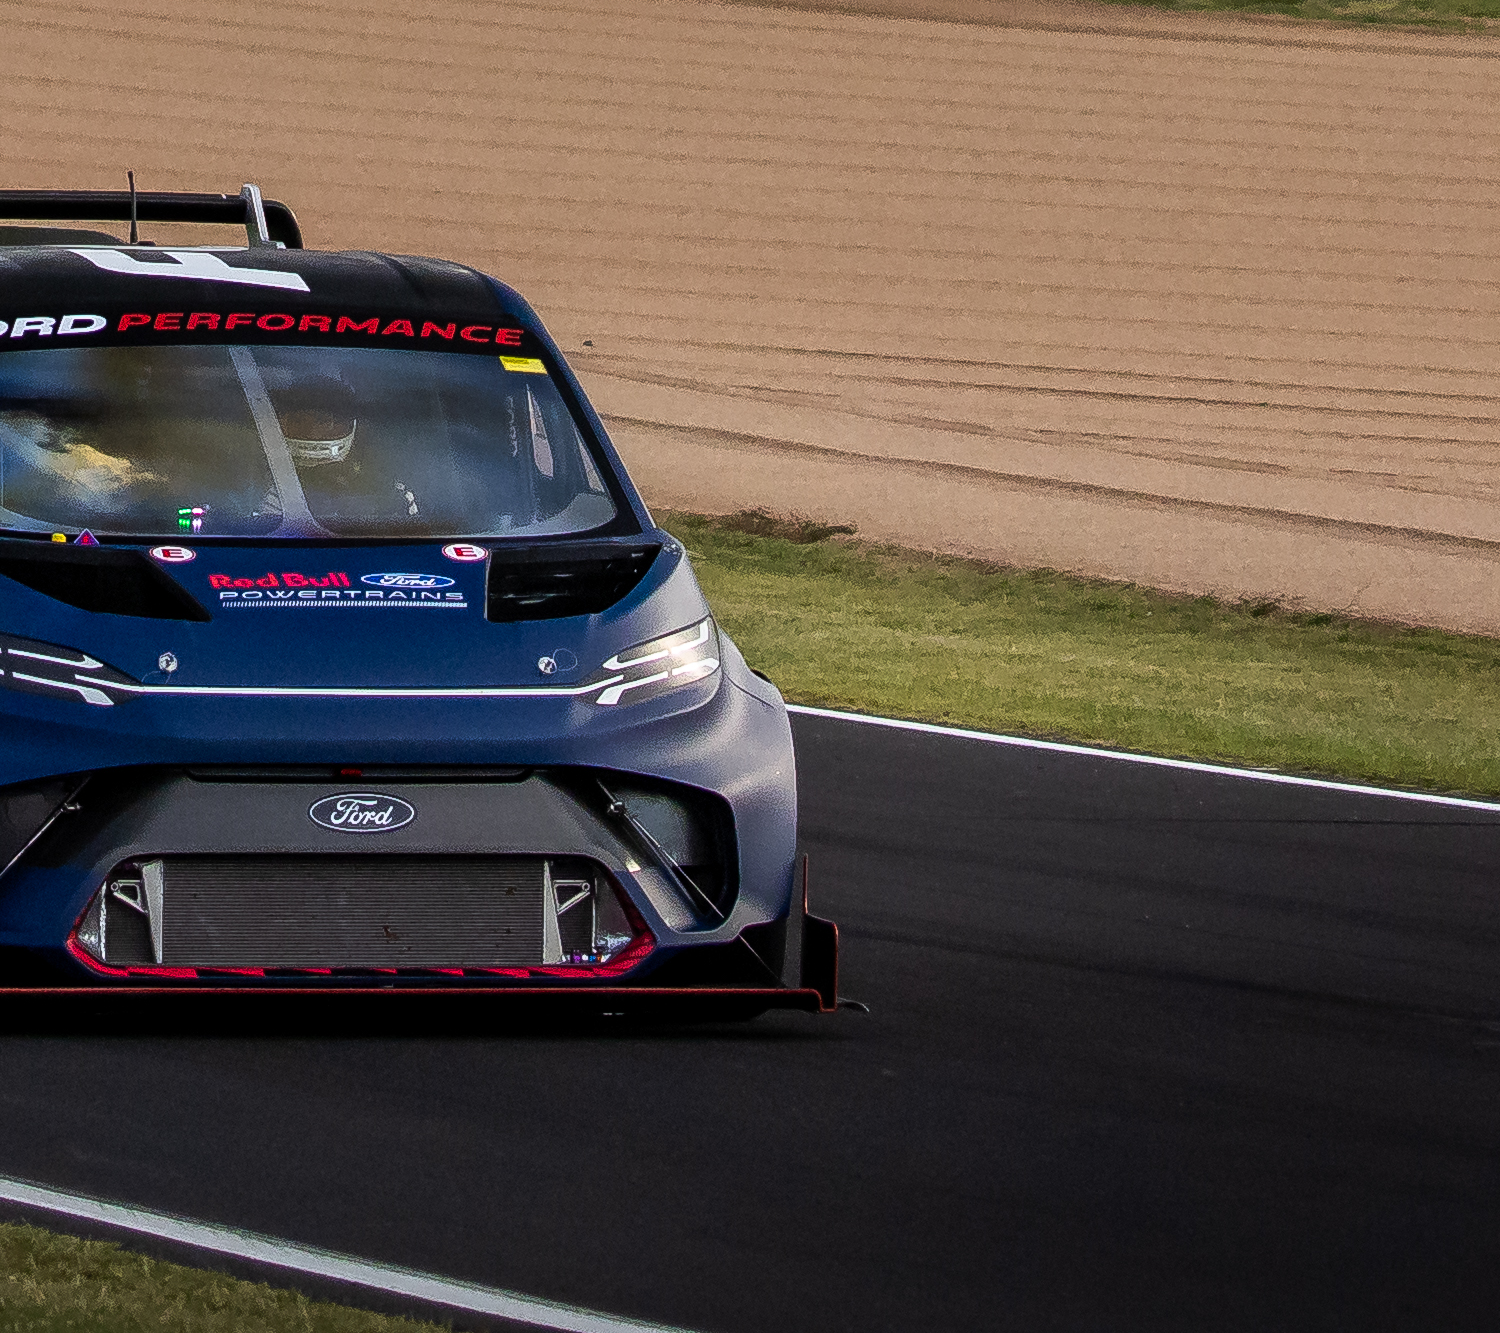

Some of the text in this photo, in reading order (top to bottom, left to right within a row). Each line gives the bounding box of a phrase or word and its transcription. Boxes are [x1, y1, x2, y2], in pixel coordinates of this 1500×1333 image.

[117, 311, 525, 346] PERFORMANCE
[209, 572, 351, 588] Red Bull
[219, 590, 464, 600] POWERTRAINS
[330, 799, 394, 824] Ford
